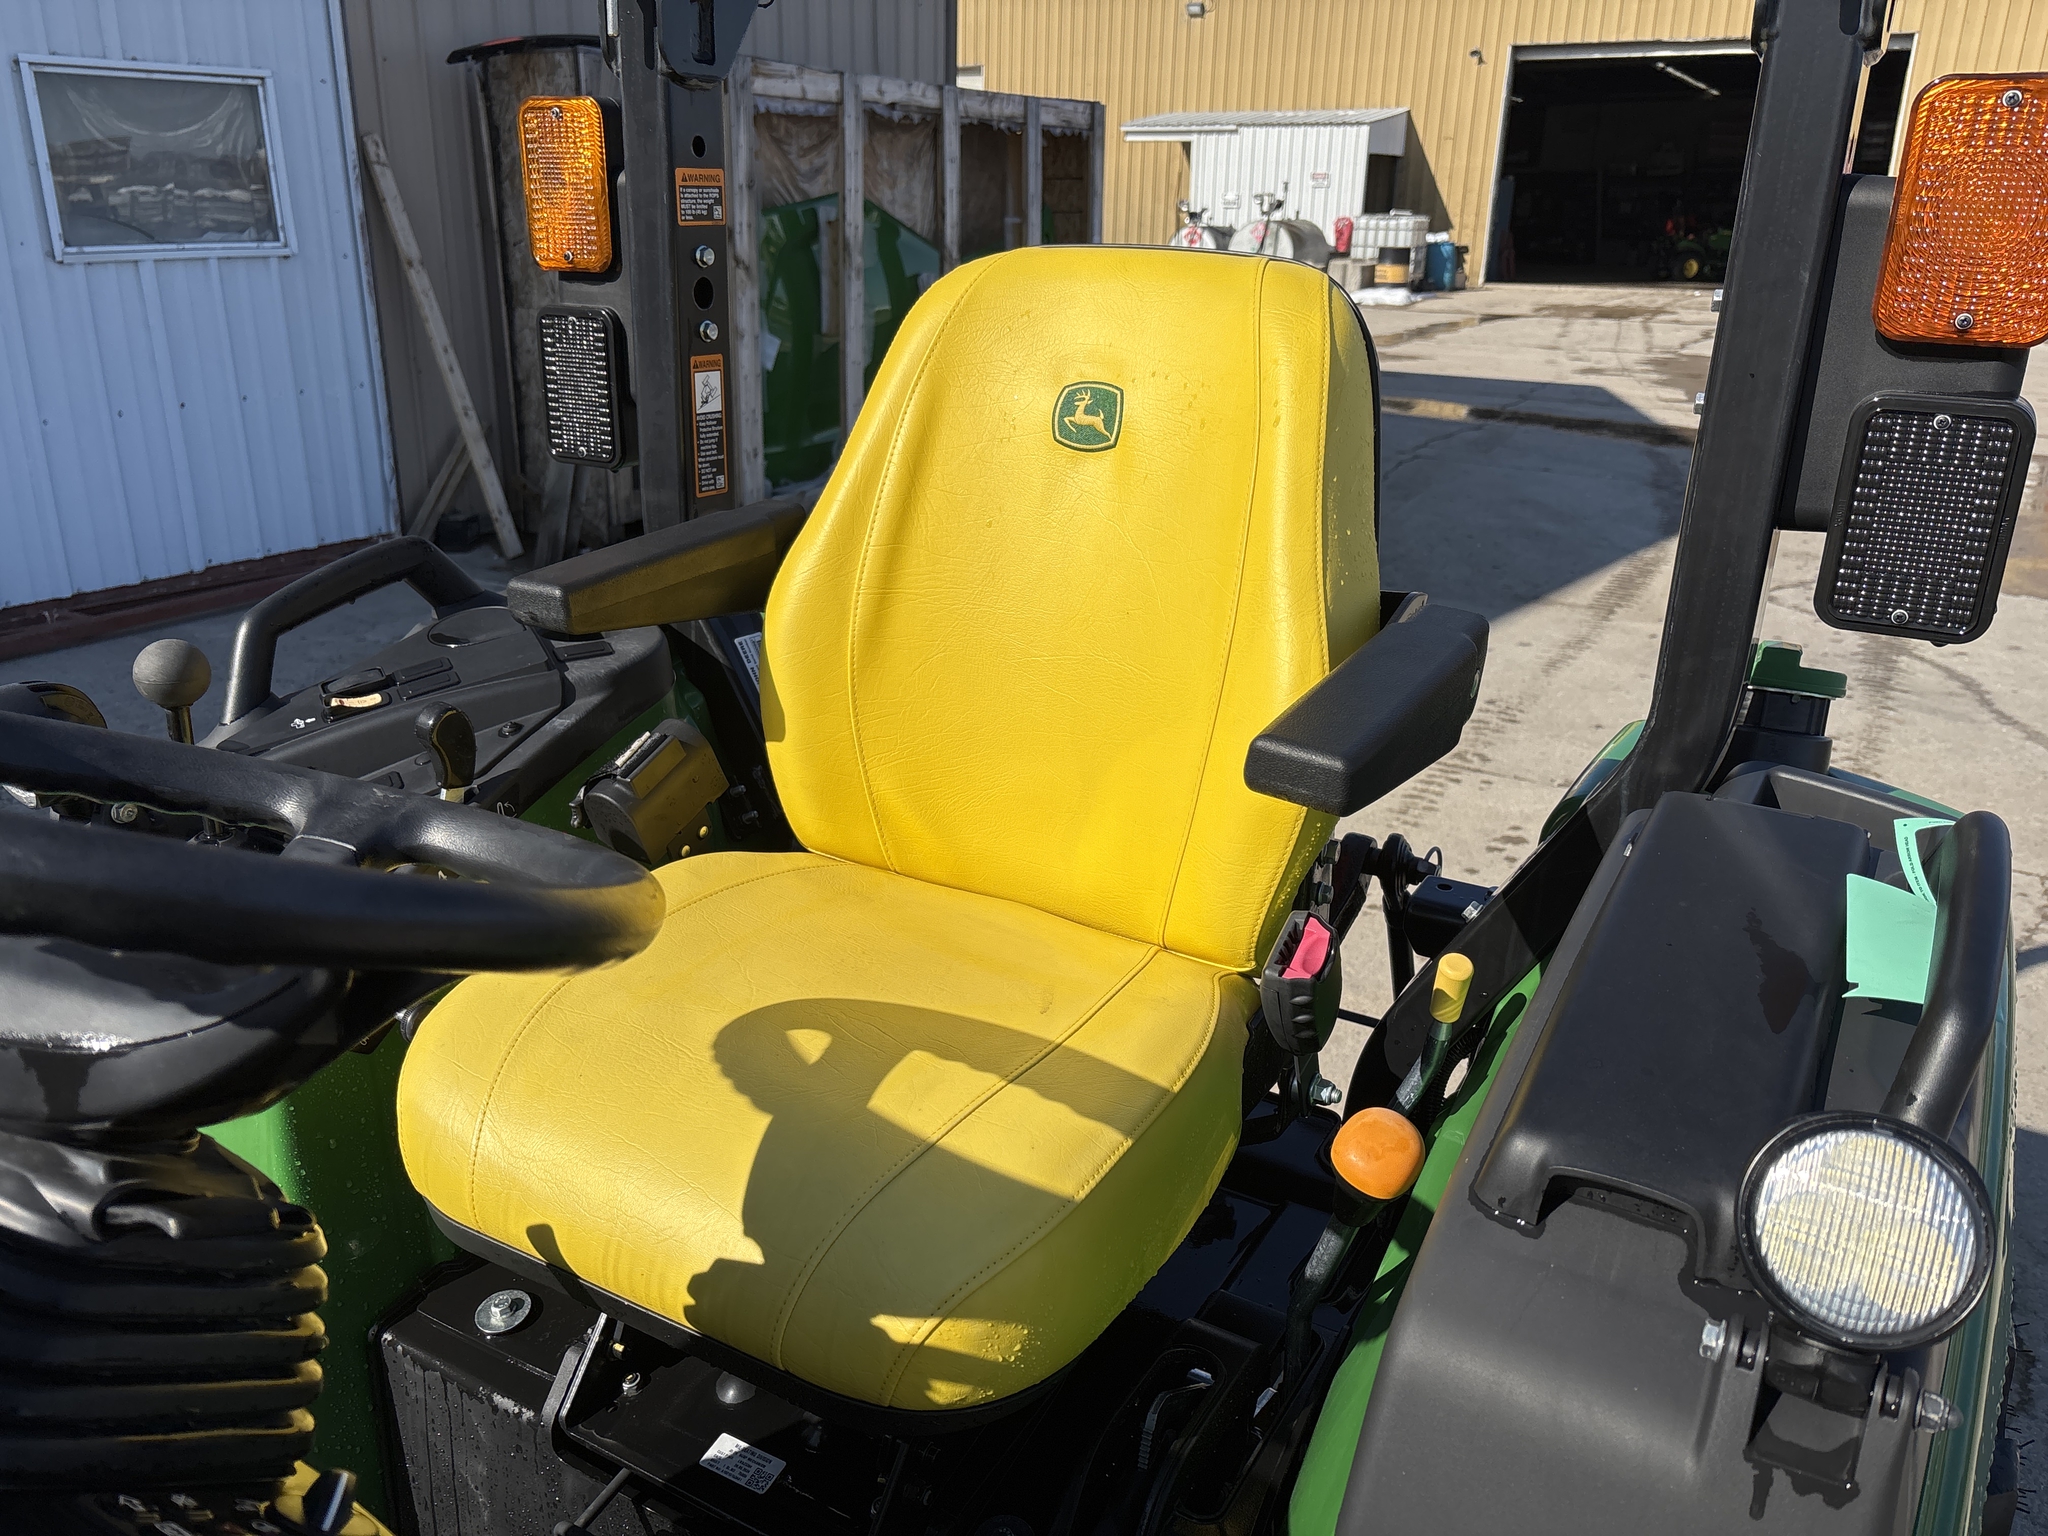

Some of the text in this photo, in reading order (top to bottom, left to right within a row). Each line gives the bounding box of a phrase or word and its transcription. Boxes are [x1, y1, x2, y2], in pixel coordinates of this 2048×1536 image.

[688, 174, 720, 183] WARNING
[698, 359, 721, 368] WARNING
[738, 640, 751, 664] DEERE
